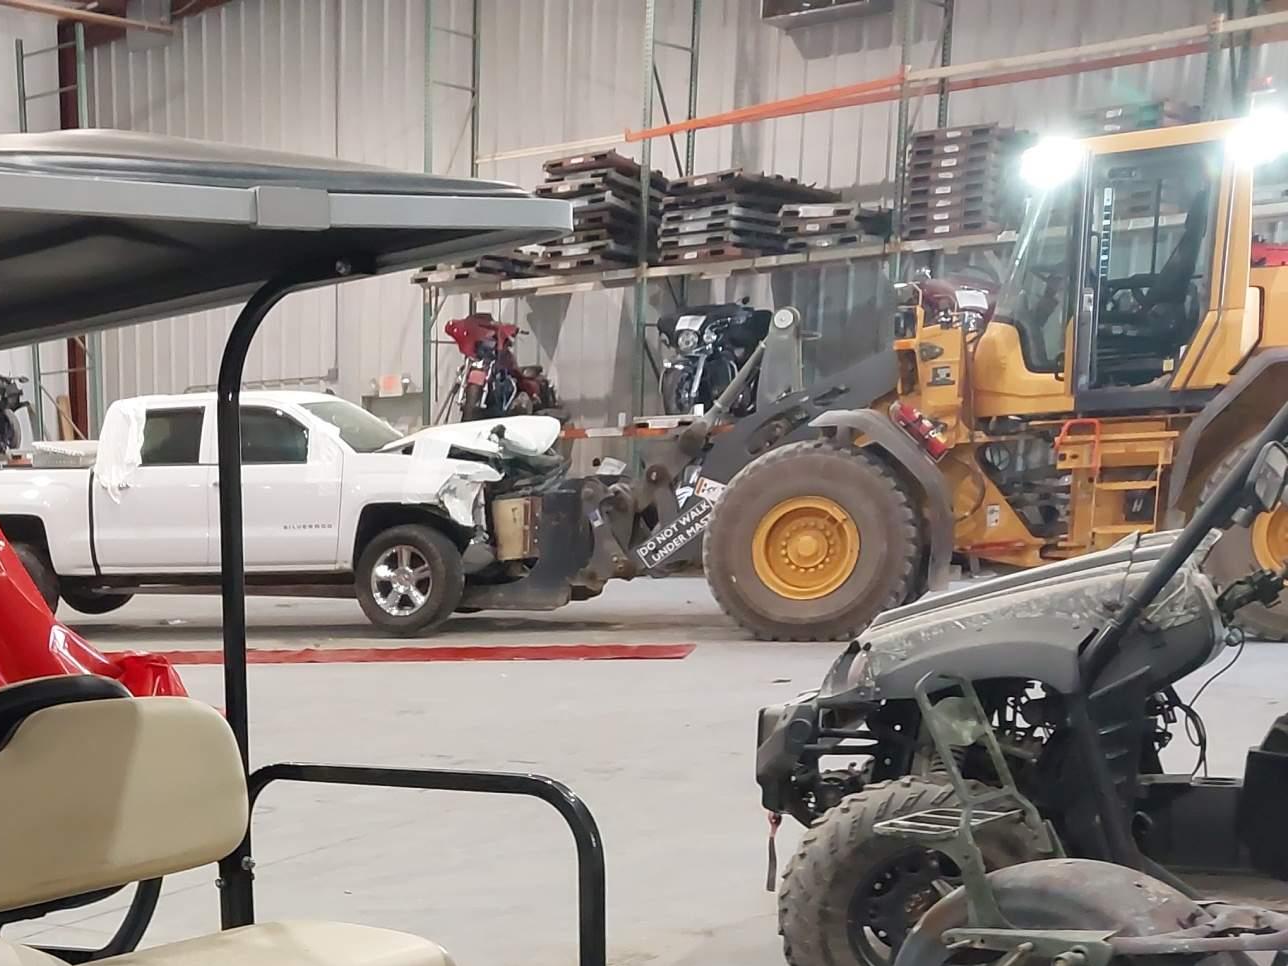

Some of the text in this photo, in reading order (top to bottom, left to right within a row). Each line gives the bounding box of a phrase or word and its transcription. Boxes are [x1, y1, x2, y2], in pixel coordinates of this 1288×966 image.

[639, 500, 710, 557] DO NOT WALK
[651, 514, 711, 562] UNDER MAS
